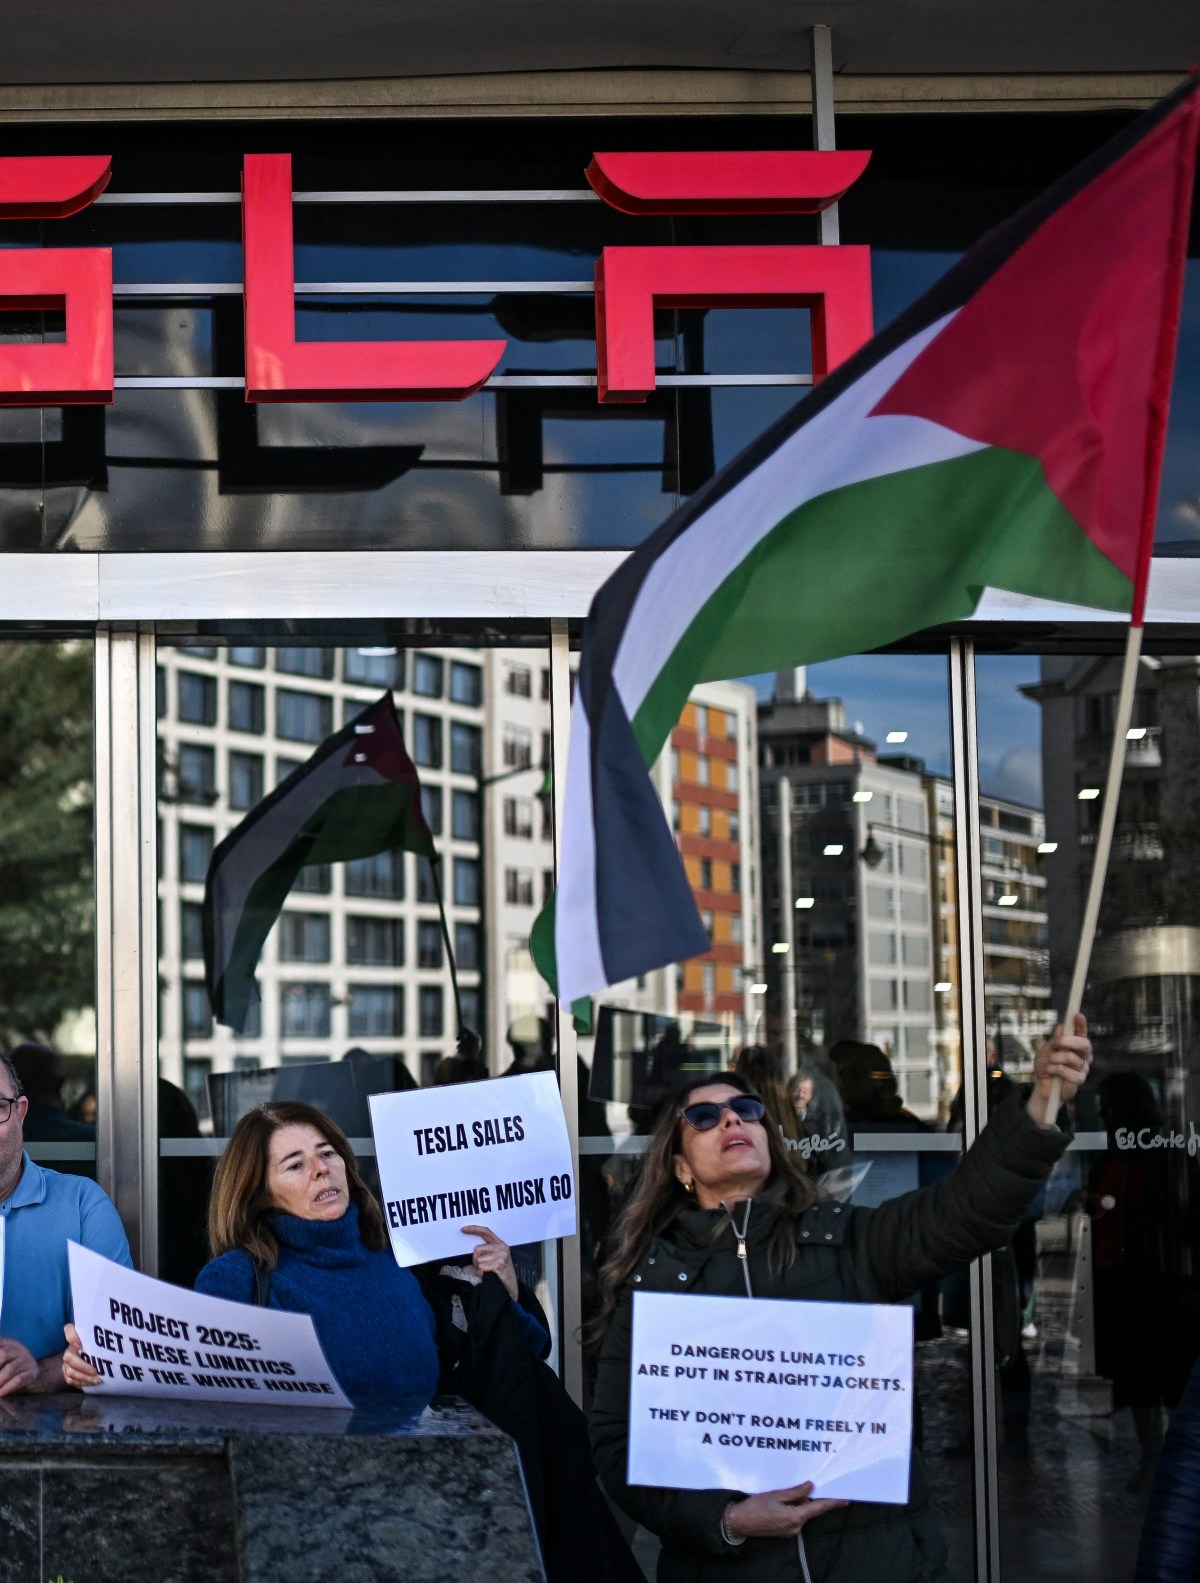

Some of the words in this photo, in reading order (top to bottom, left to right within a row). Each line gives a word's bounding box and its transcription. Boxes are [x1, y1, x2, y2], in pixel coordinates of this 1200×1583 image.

[414, 1123, 469, 1156] TESLA
[472, 1115, 525, 1148] SALES
[1137, 1128, 1185, 1150] Corte
[387, 1187, 492, 1229] EVERYTHING
[495, 1177, 546, 1211] MUSK
[550, 1173, 572, 1202] GO
[109, 1297, 190, 1342] PROJECT
[196, 1325, 261, 1352] 2025:
[93, 1325, 125, 1354] GET
[129, 1337, 191, 1368] THESE
[194, 1351, 297, 1376] LUNATICS
[671, 1344, 775, 1363] DANGEROUS
[781, 1350, 866, 1368] LUNATICS
[120, 1363, 145, 1382] OF
[149, 1368, 190, 1386] THE
[192, 1373, 260, 1391] WHITE
[264, 1379, 336, 1395] HOUSE
[637, 1363, 670, 1378] ARE
[675, 1366, 708, 1380] PUT
[713, 1368, 729, 1382] IN
[734, 1369, 906, 1392] STRAIGHTJACKETS.
[649, 1408, 691, 1422] THEY
[696, 1411, 746, 1427] DON'T
[751, 1415, 801, 1430] ROAM
[805, 1419, 867, 1435] FREELY
[871, 1422, 887, 1435] IN
[702, 1433, 714, 1446] A
[718, 1434, 837, 1453] GOVERNMENT.
